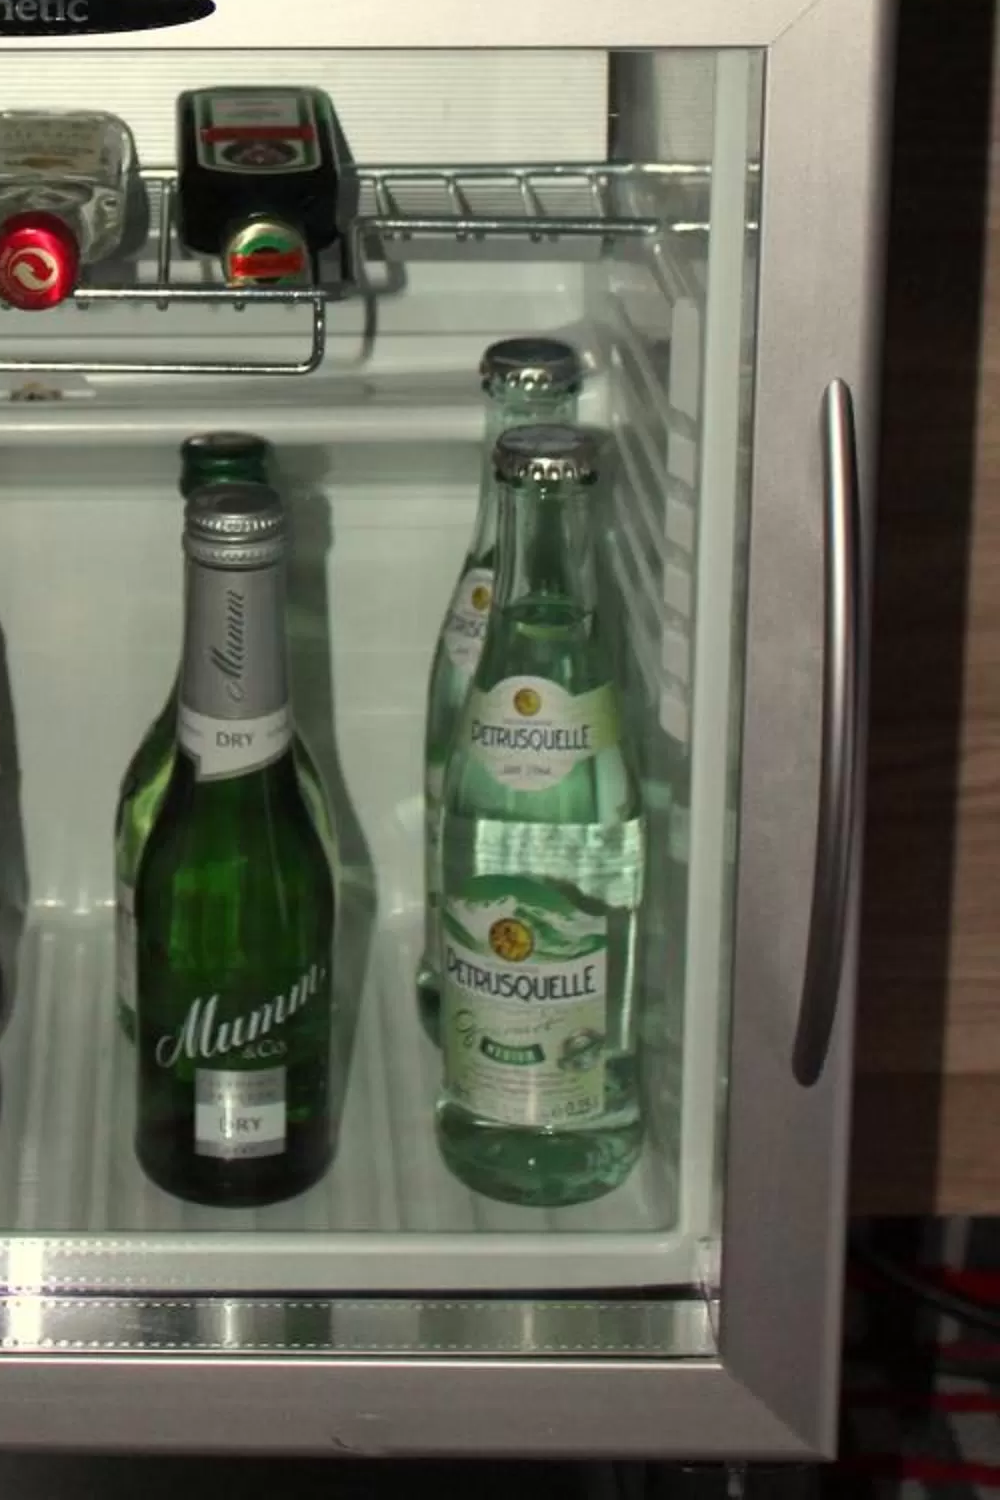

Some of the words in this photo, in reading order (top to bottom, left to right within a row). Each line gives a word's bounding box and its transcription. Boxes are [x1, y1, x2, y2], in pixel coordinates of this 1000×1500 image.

[215, 730, 254, 749] DRY
[471, 719, 592, 751] PETRUSQUELLE
[447, 947, 597, 1002] PETRUSQUELLE
